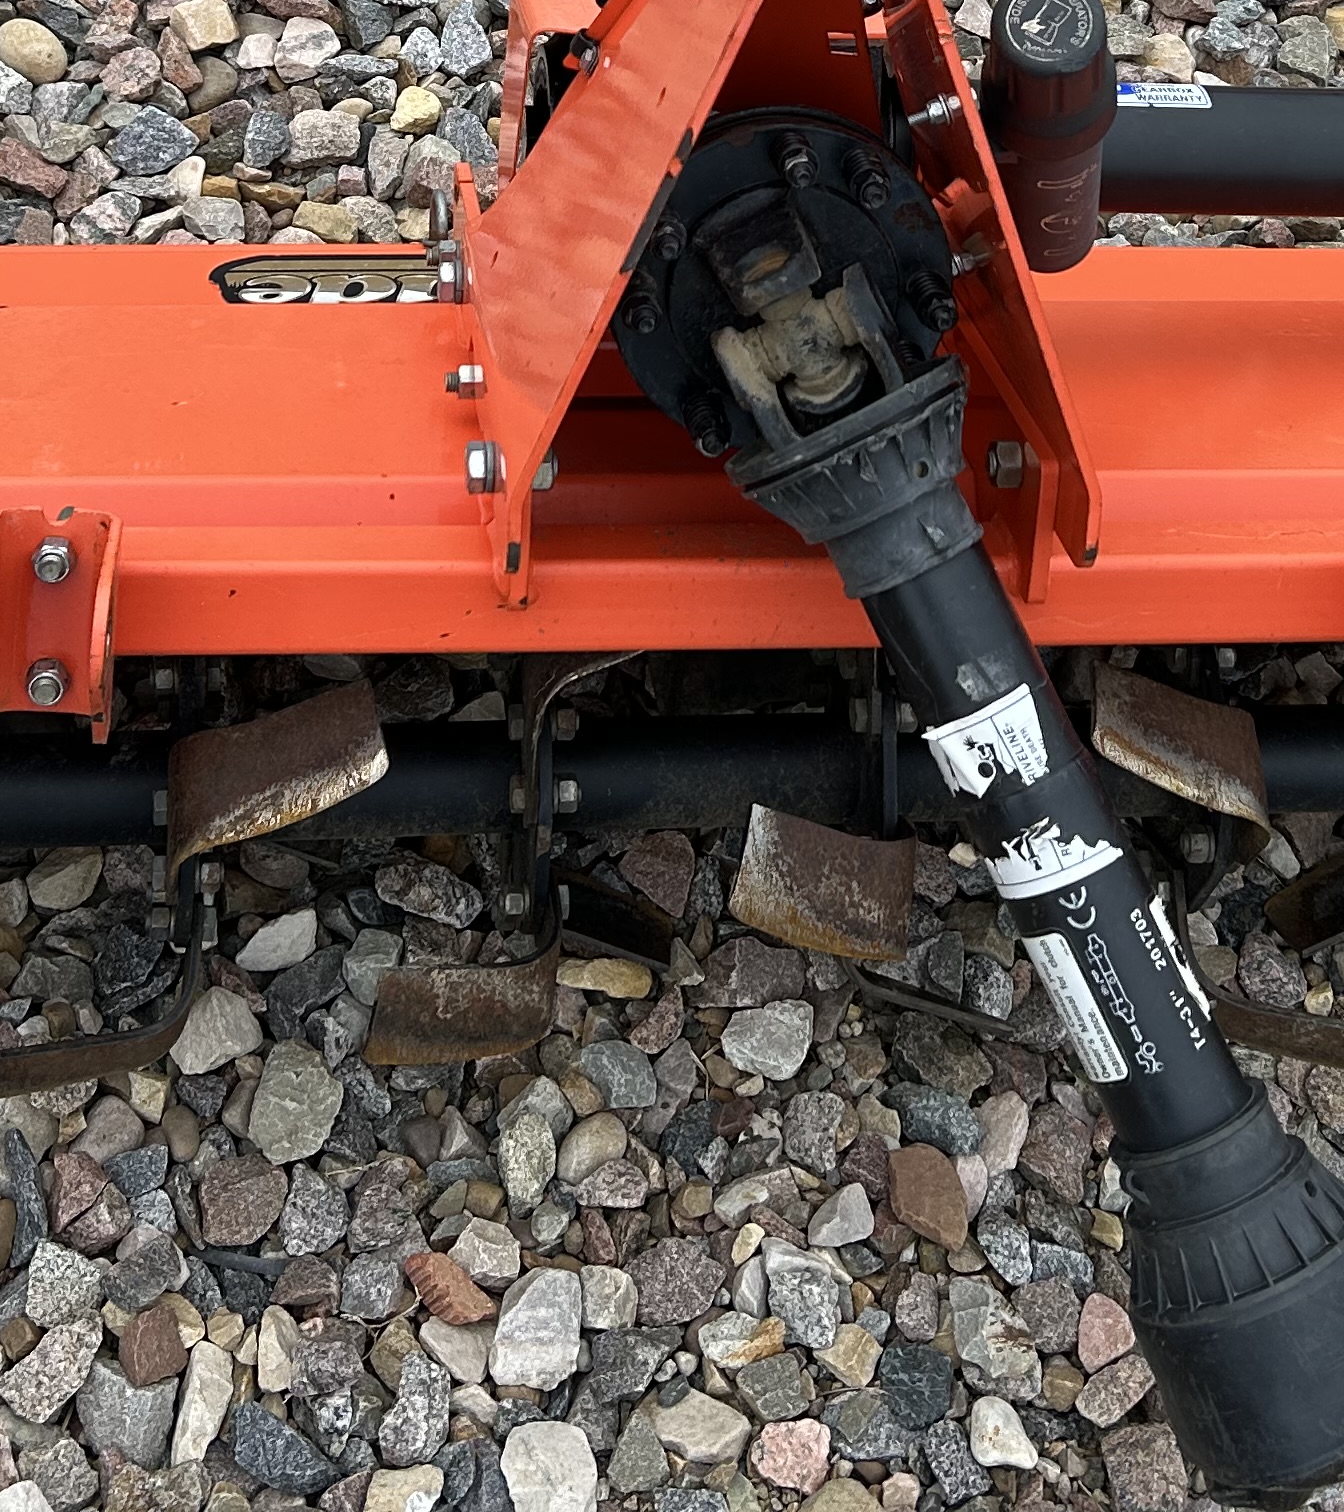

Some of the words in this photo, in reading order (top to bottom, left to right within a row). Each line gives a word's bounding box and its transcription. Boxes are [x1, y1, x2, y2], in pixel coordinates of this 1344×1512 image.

[1003, 726, 1038, 781] RIVELINE
[1038, 939, 1058, 969] clutch
[1128, 906, 1169, 972] 201703
[1055, 975, 1068, 990] for
[1064, 994, 1090, 1034] Manual
